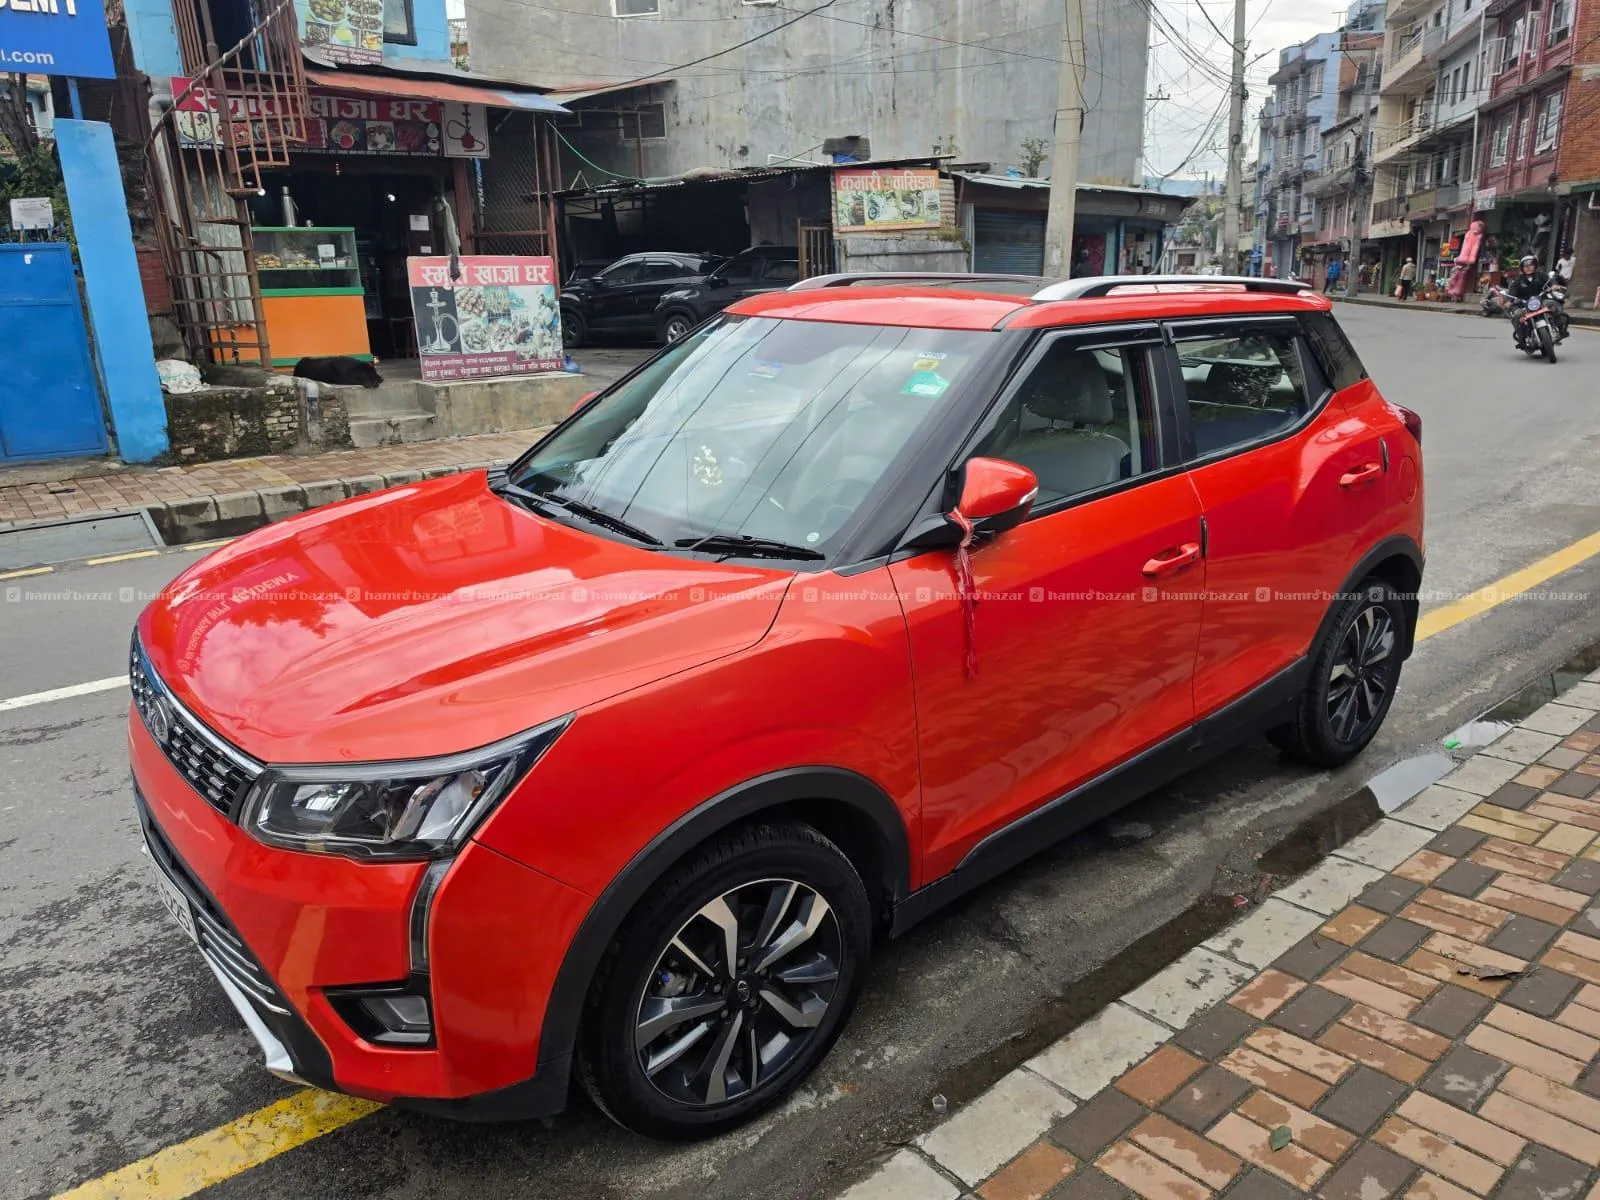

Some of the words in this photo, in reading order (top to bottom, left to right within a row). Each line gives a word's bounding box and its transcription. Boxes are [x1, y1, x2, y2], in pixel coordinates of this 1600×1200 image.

[390, 100, 433, 123] घर
[473, 265, 519, 284] खाजा
[525, 264, 550, 284] घर
